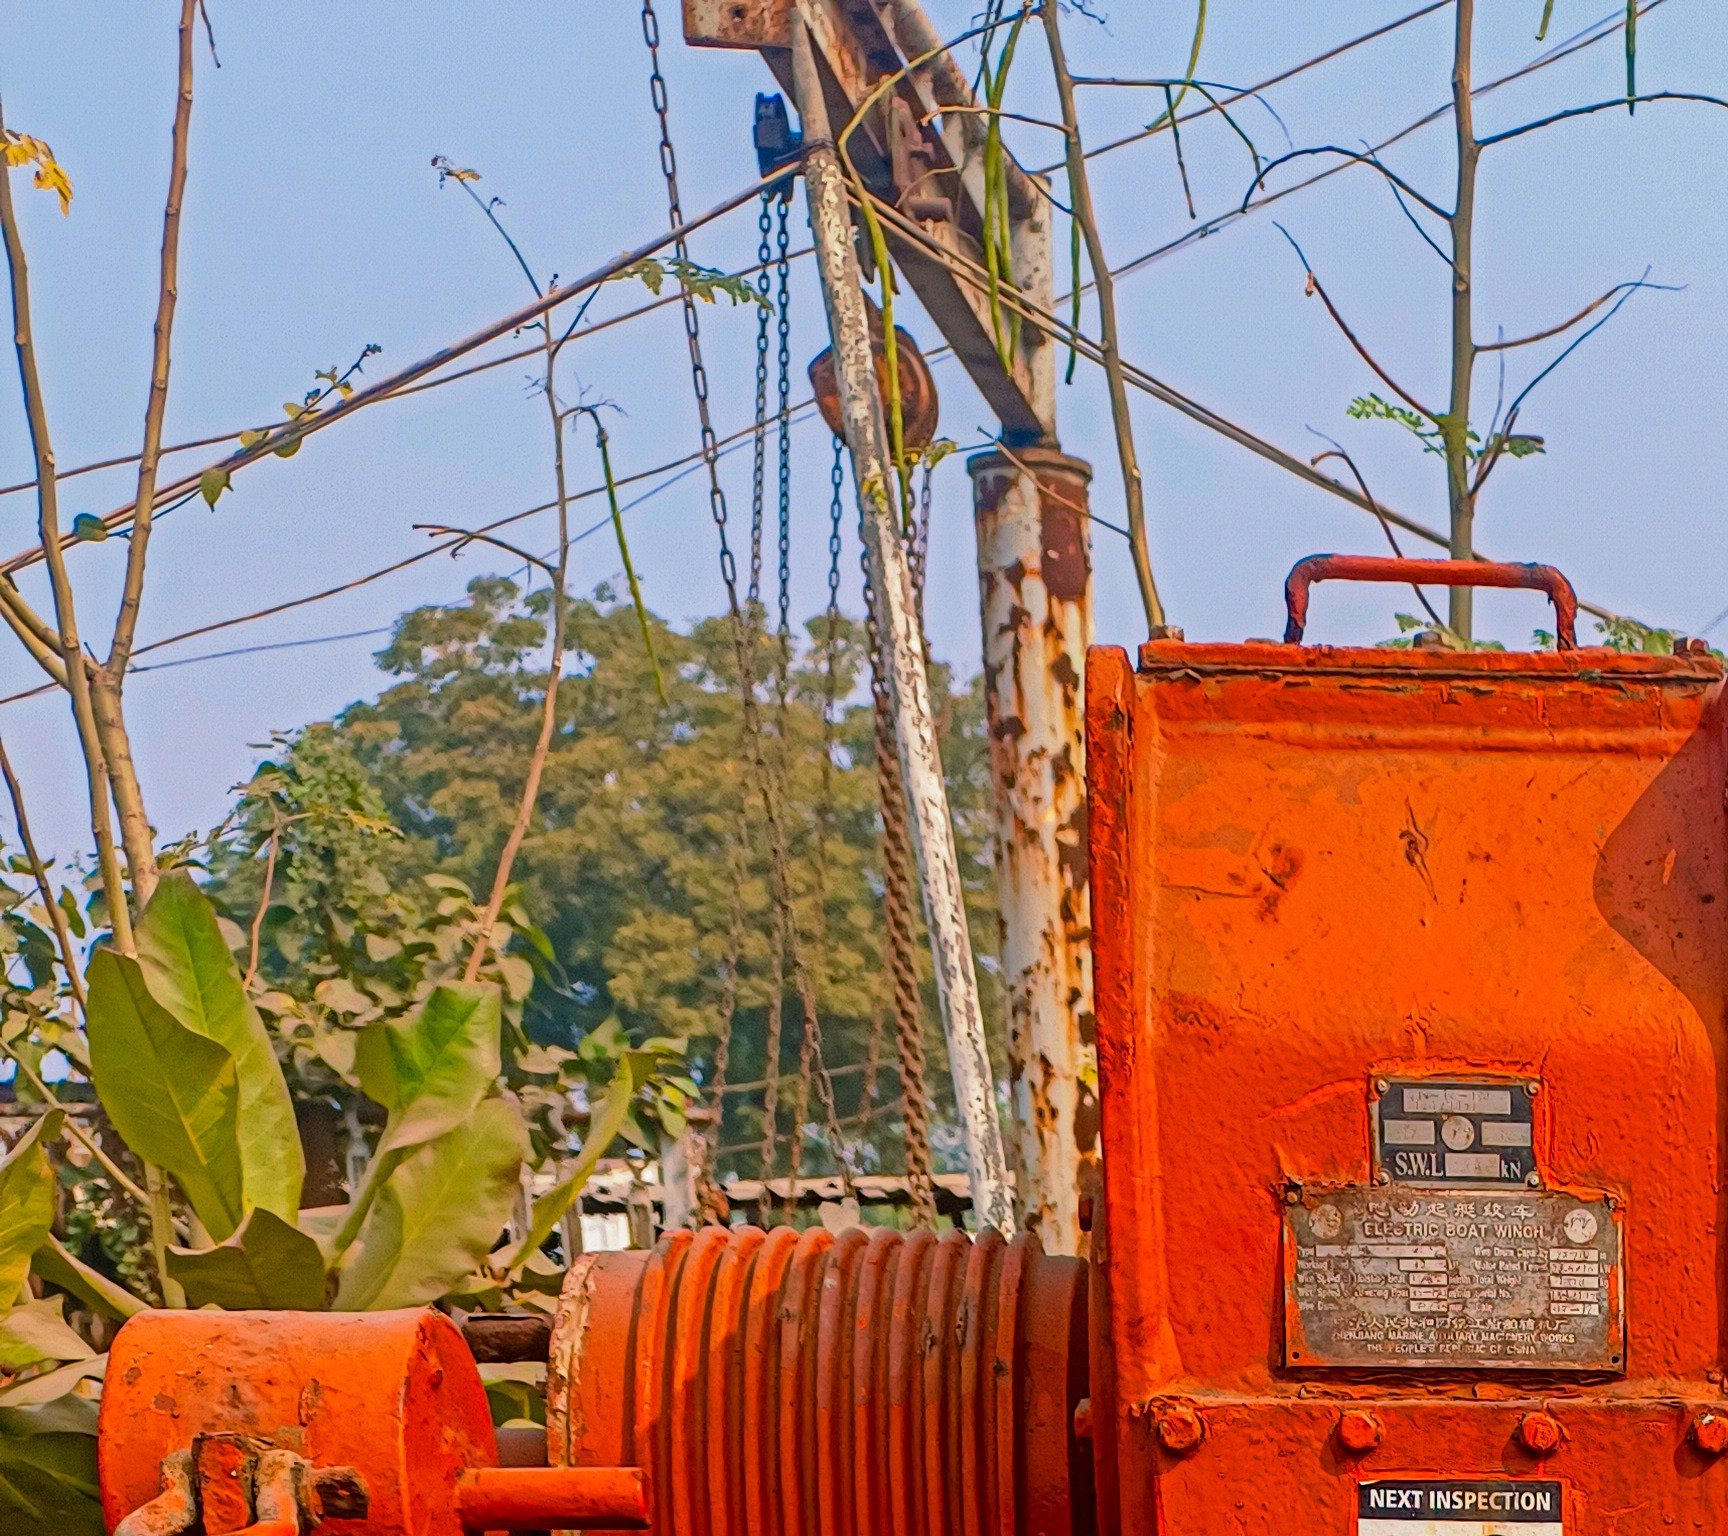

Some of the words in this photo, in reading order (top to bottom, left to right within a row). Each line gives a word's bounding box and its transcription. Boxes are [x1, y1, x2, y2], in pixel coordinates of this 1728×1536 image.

[1501, 1159, 1521, 1179] kN
[1446, 1223, 1488, 1239] BOAT
[1388, 1330, 1425, 1341] MARINE
[1369, 1489, 1424, 1509] NEXT
[1429, 1490, 1551, 1511] INSPECTION
